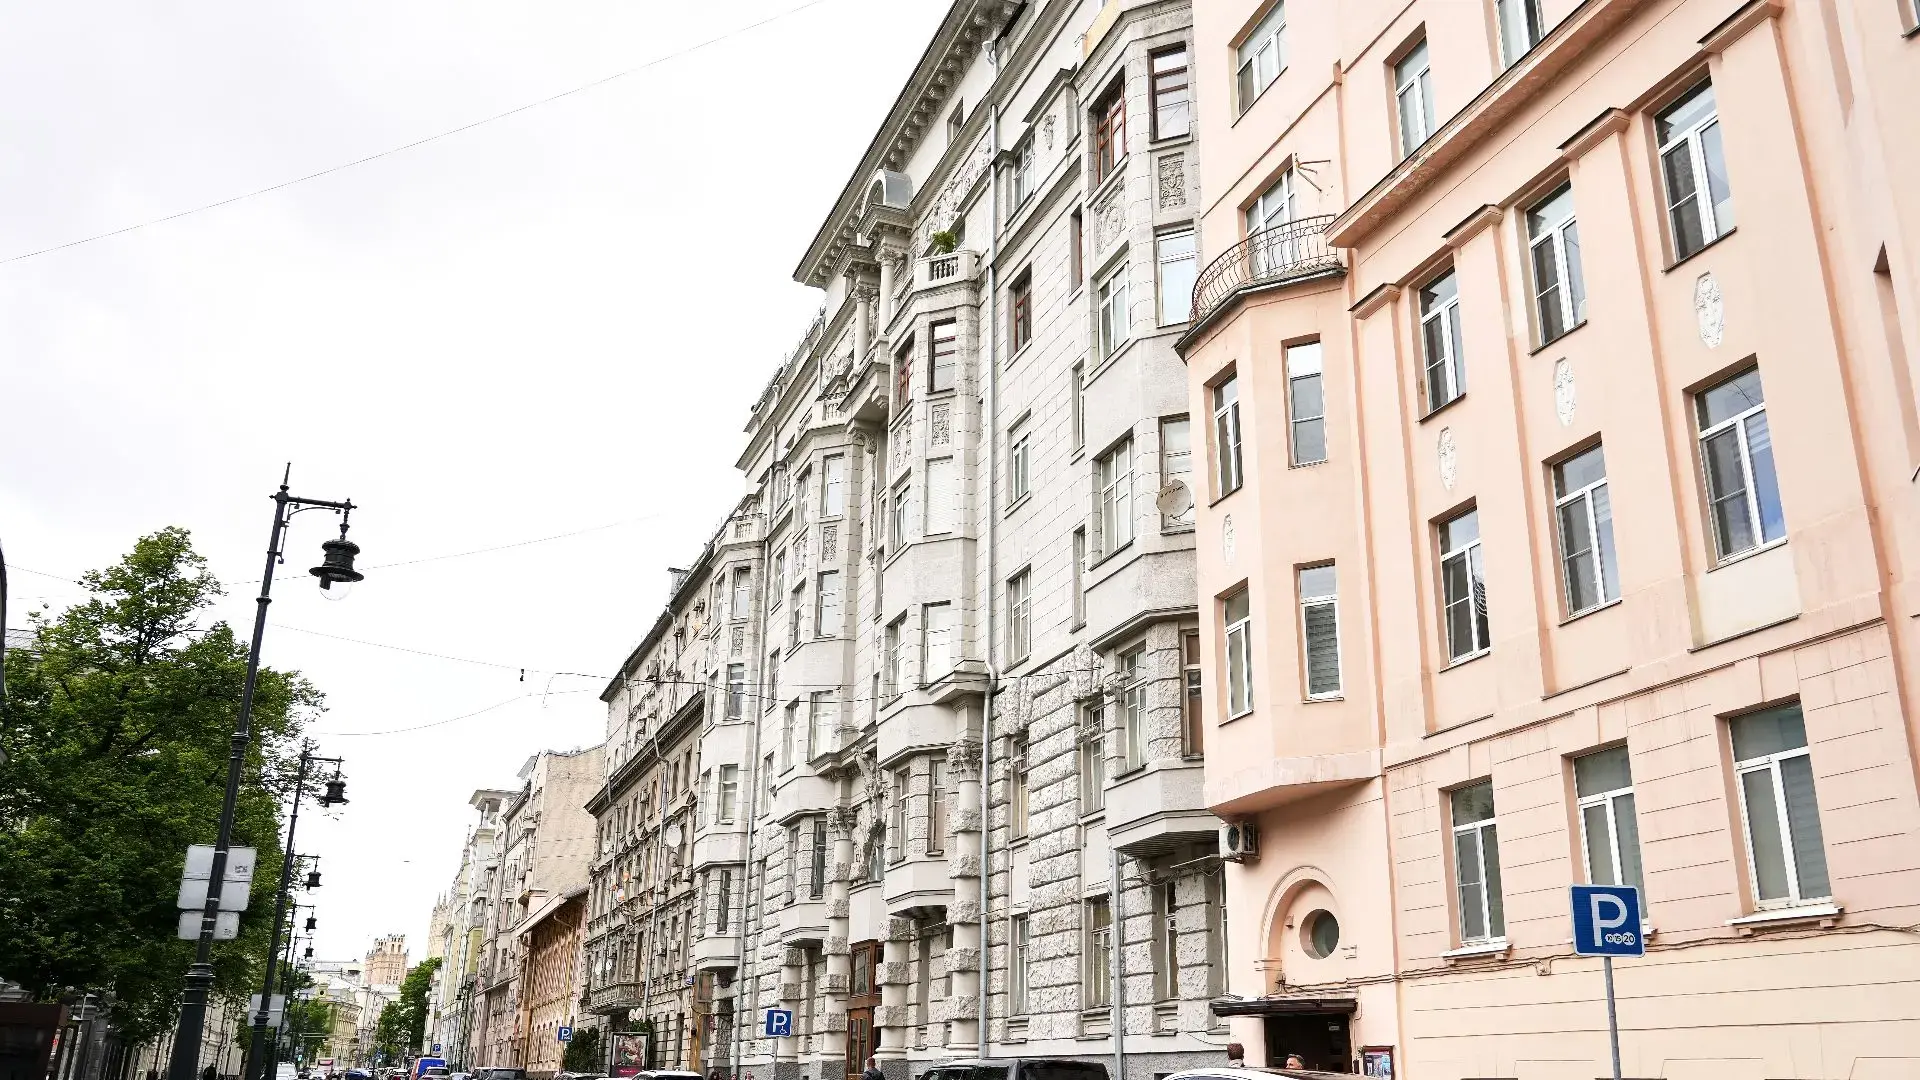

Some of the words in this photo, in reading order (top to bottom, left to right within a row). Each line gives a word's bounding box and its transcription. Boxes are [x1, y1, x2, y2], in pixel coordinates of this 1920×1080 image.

[1590, 893, 1628, 947] P
[1623, 934, 1635, 943] 20
[772, 1012, 788, 1033] P
[562, 1028, 570, 1039] P
